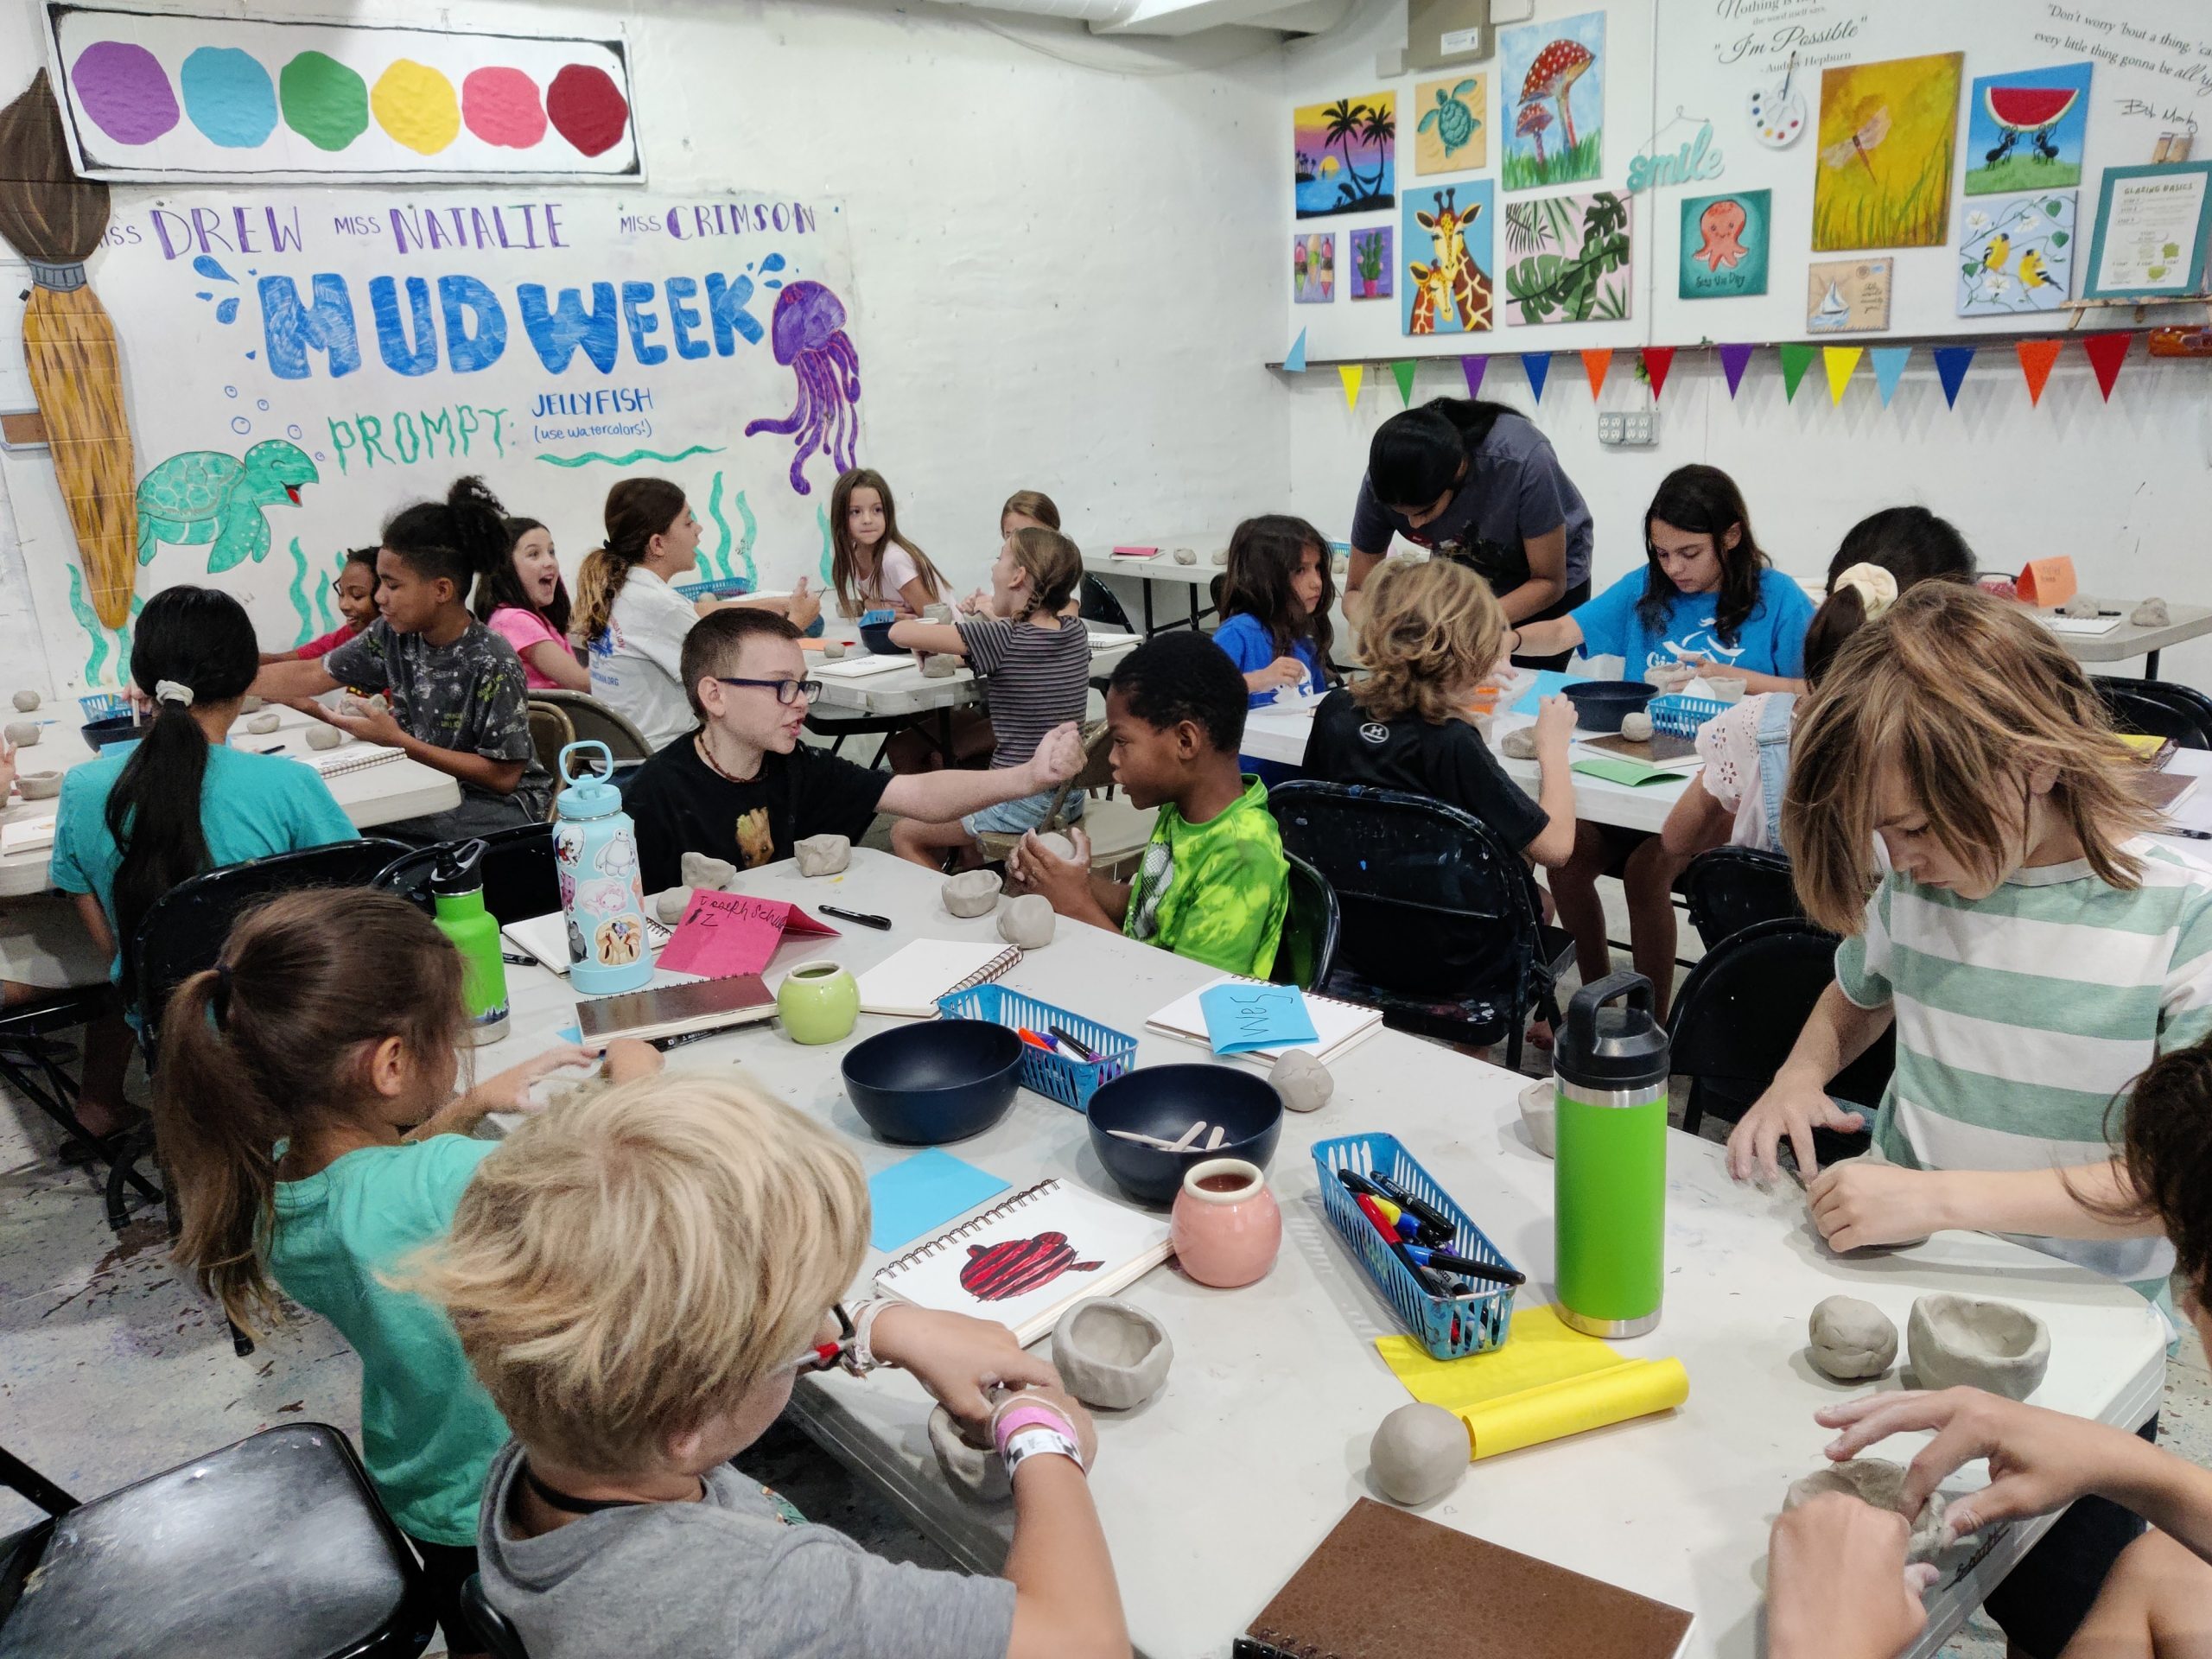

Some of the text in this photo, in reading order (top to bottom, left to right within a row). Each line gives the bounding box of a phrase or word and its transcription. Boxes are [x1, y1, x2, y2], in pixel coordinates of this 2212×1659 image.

[2084, 16, 2116, 35] worry
[2150, 34, 2158, 42] a
[2034, 31, 2062, 47] every
[2064, 35, 2088, 53] little
[2090, 43, 2119, 65] thing
[2120, 54, 2155, 72] gonna
[2159, 60, 2174, 75] be
[2173, 63, 2208, 82] all
[1626, 123, 1726, 194] smile
[99, 202, 817, 260] ISS DREW MISS NATALIE MISS CRIMSON
[531, 387, 654, 417] JELLYFISH
[534, 425, 566, 444] (use
